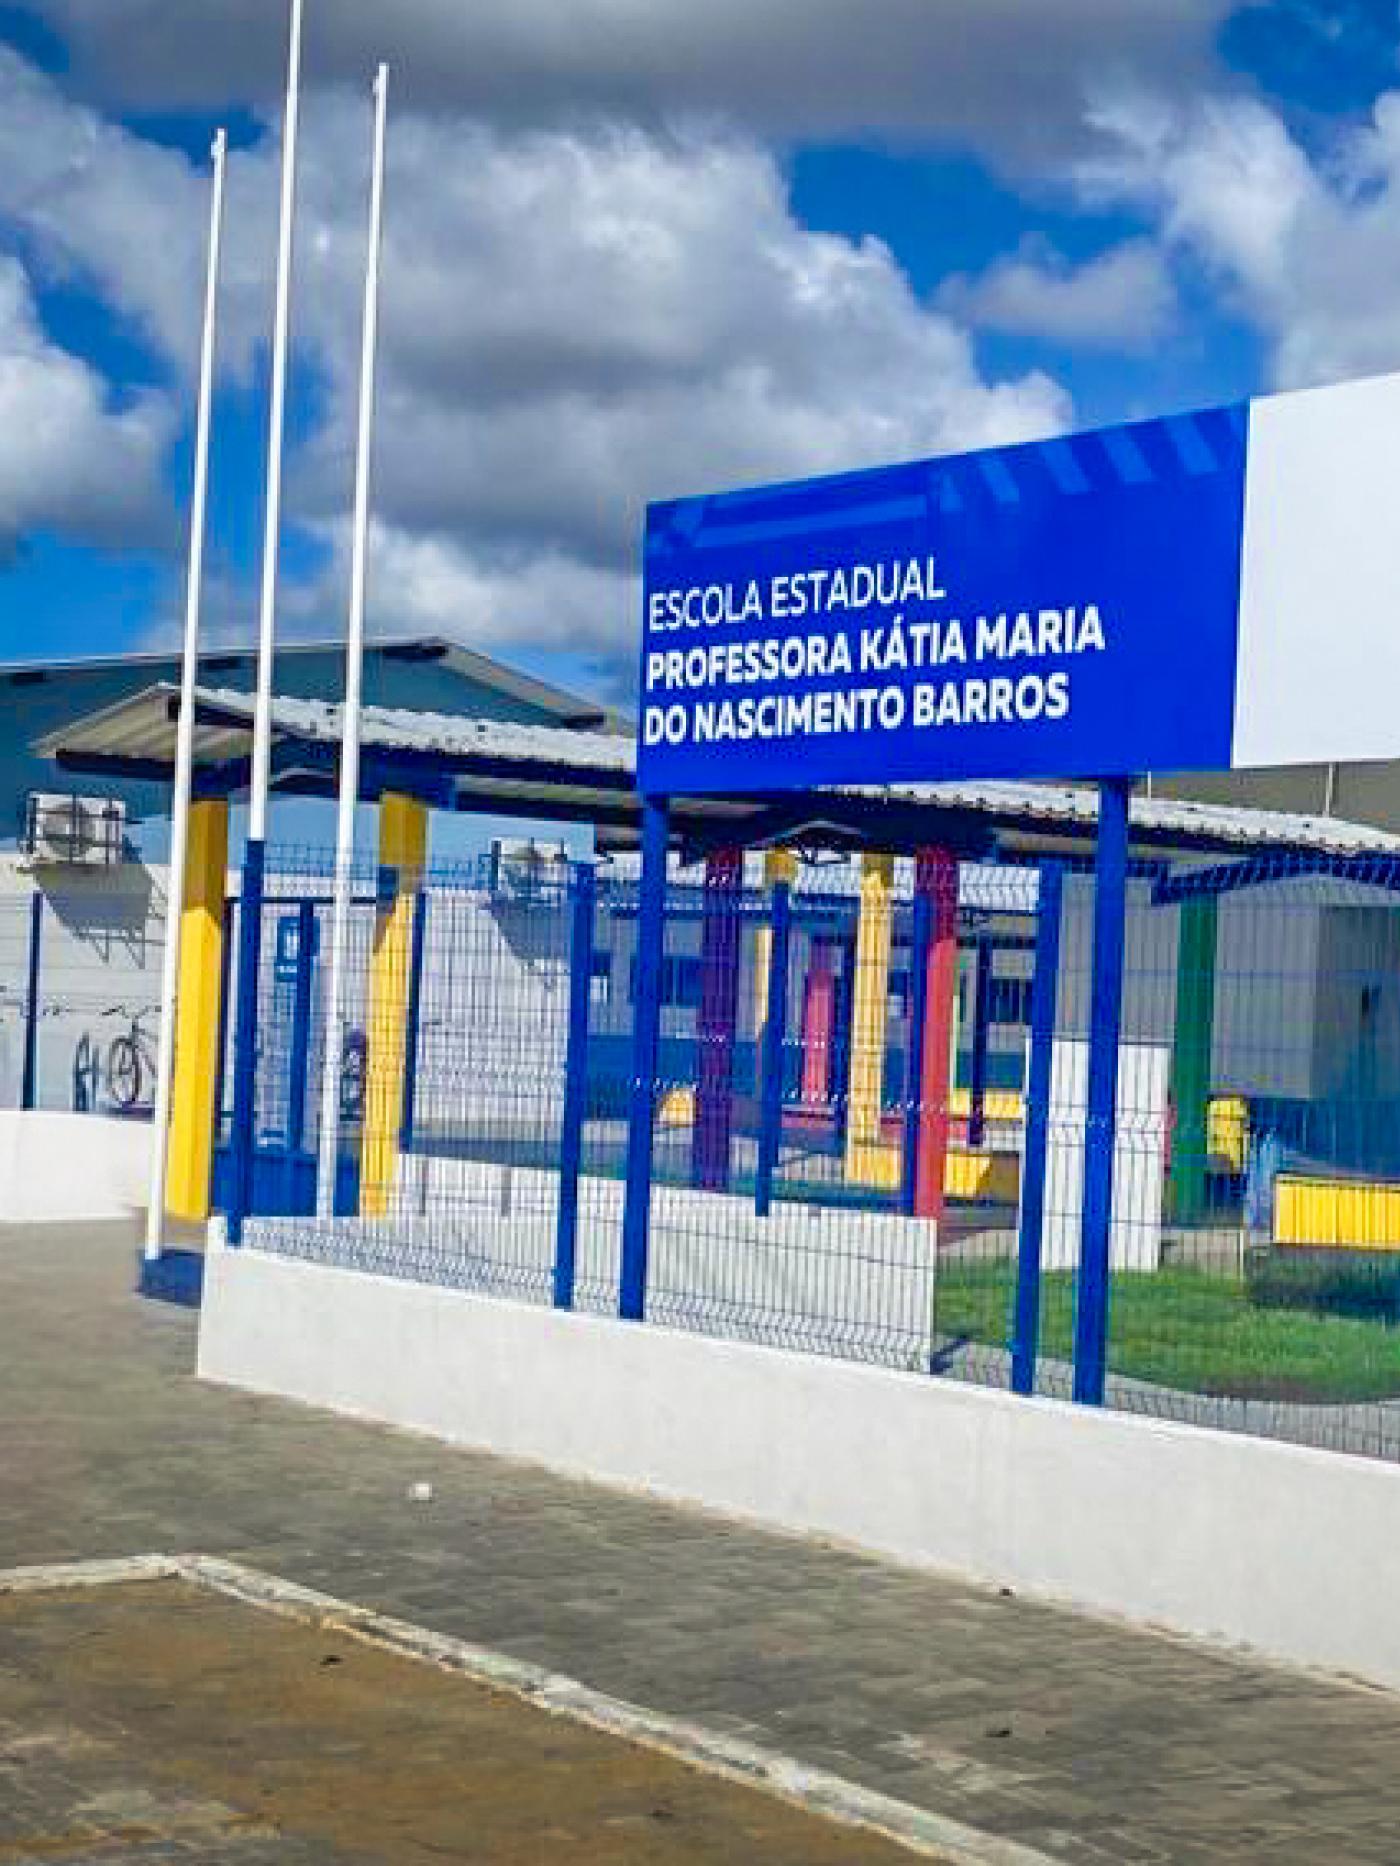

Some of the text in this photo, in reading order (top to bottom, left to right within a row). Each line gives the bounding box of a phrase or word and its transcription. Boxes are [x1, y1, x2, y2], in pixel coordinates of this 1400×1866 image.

[649, 556, 946, 632] ESCOLA ESTADUAL
[645, 604, 1106, 691] PROFESSORA KÁTIA MARIA
[644, 672, 1071, 746] DO NASCIMENTO BARROS
